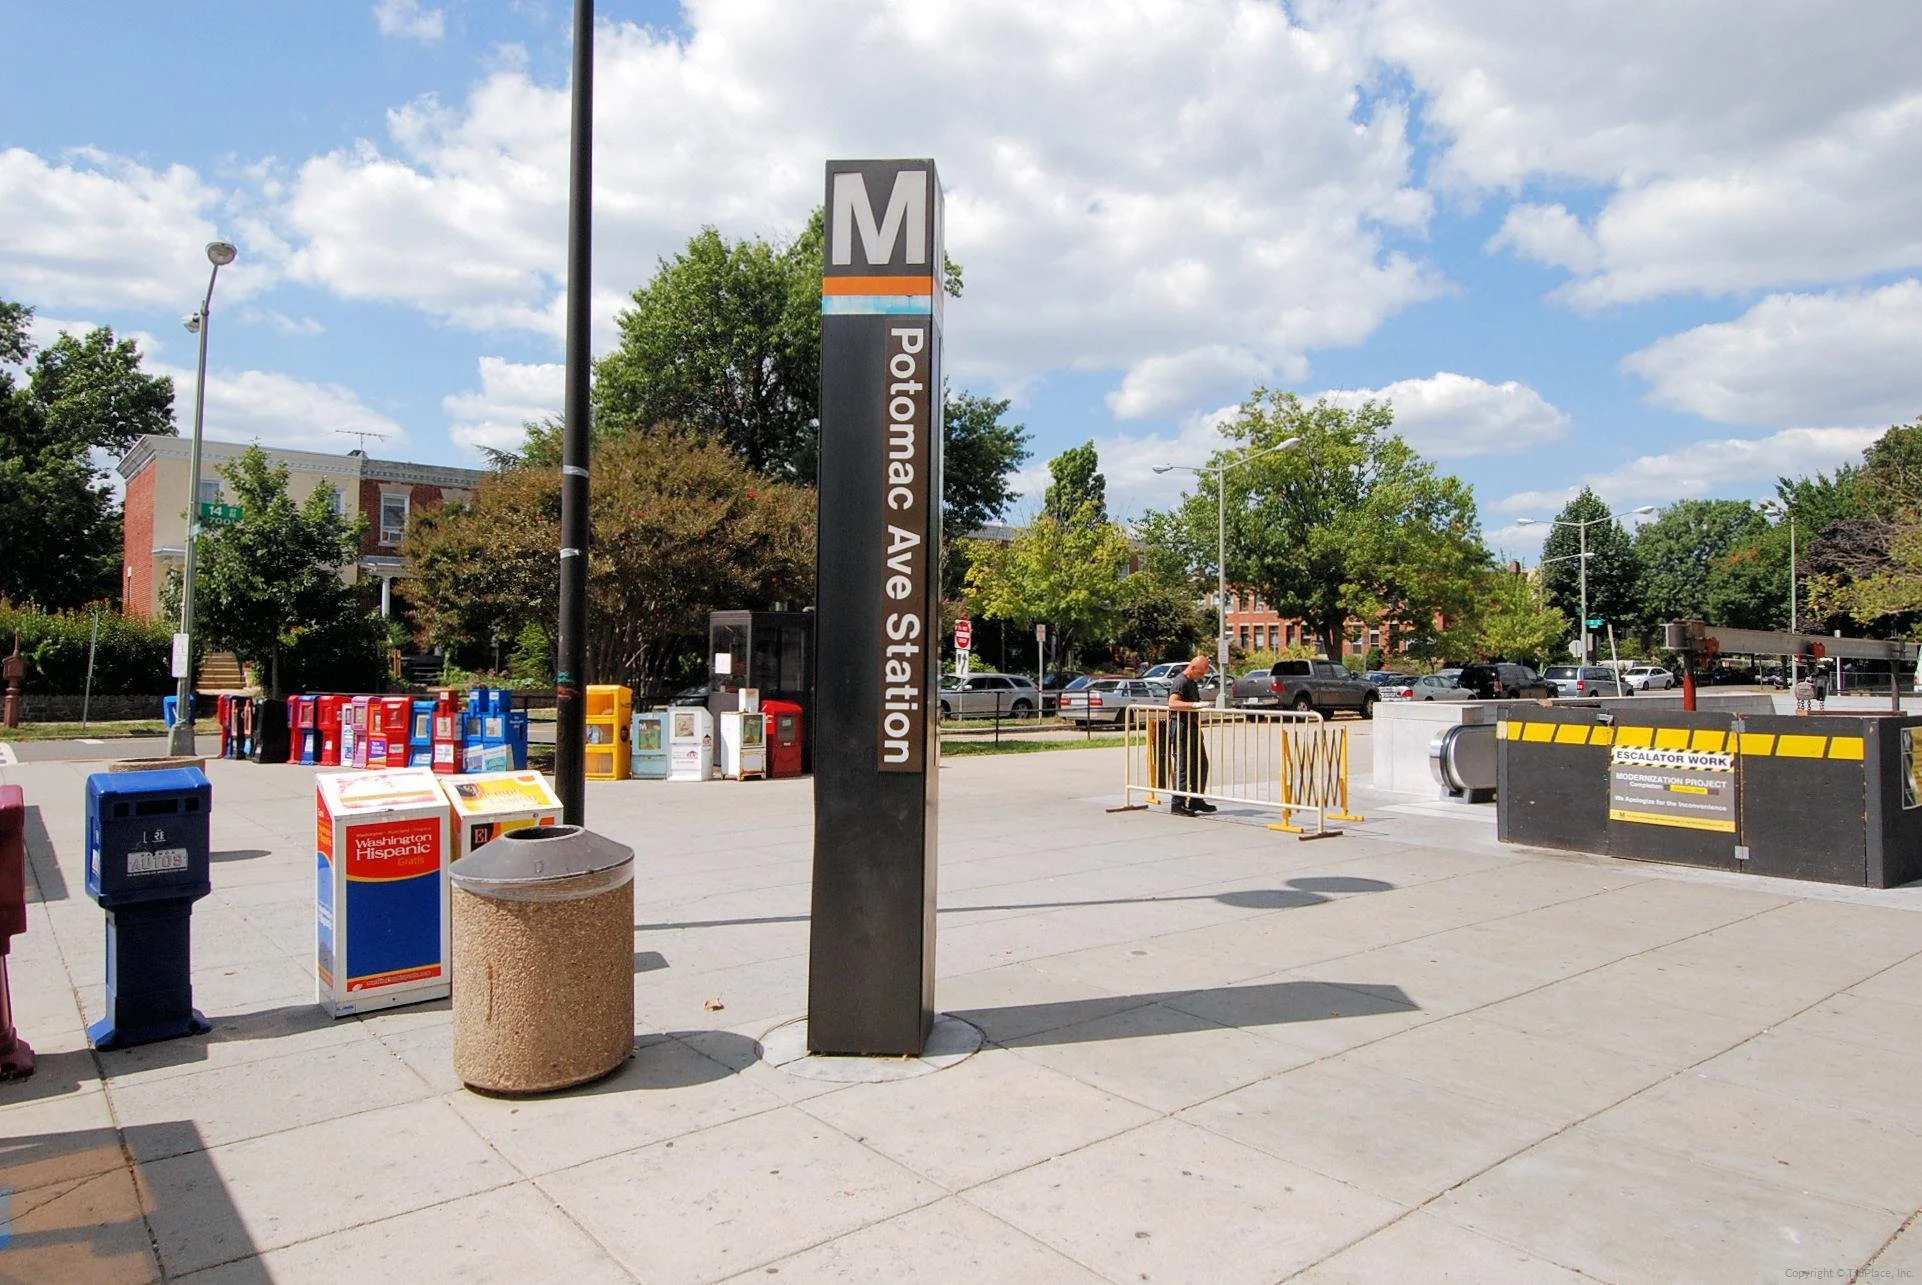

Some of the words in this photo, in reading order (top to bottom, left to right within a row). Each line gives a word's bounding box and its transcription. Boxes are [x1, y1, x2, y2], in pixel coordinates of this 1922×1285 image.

[832, 170, 927, 265] M
[887, 328, 924, 510] Potomac
[208, 506, 223, 516] 14
[886, 524, 921, 600] Ave
[883, 612, 921, 763] Station
[1616, 750, 1684, 764] ESCALATOR
[1688, 756, 1728, 767] WORK
[1615, 772, 1684, 785] MODERNIZATION
[1685, 778, 1727, 788] PROJECT
[355, 834, 432, 848] Washington
[474, 828, 488, 844] El
[356, 843, 431, 861] Hispanic
[397, 856, 425, 866] Gratis
